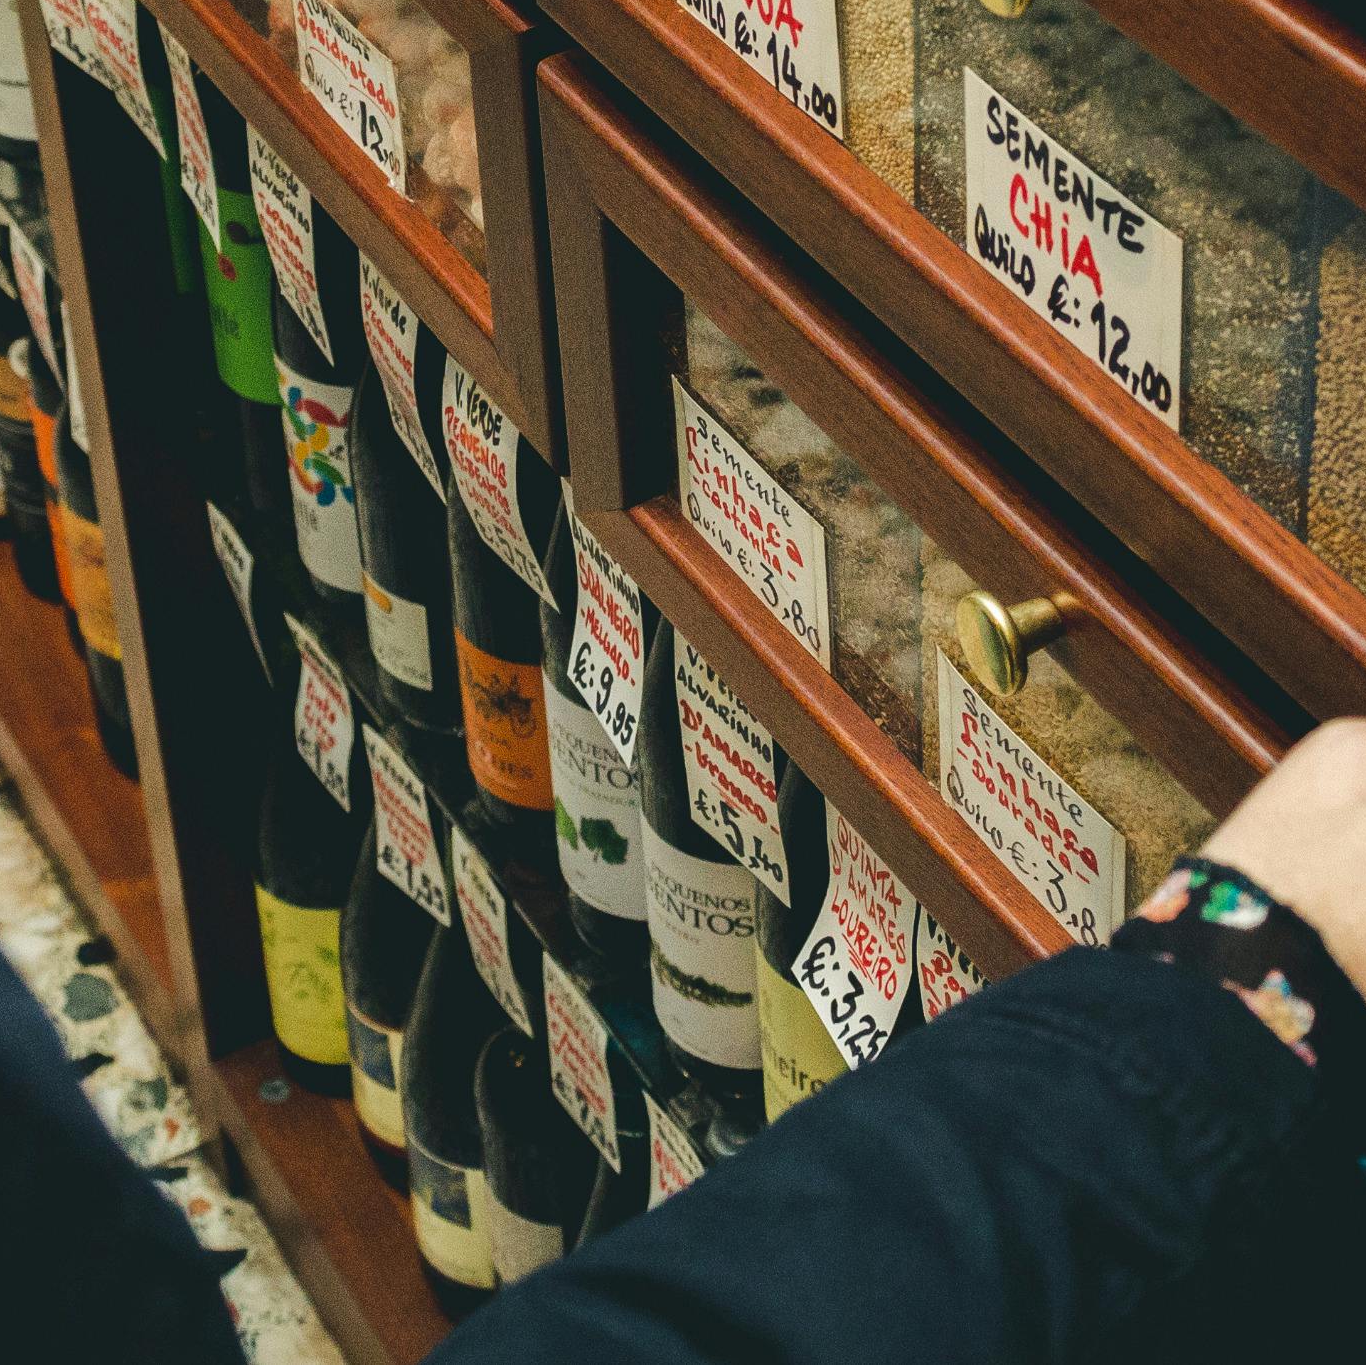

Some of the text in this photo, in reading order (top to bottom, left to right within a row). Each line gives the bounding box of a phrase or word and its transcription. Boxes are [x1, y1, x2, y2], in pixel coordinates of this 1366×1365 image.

[986, 95, 1147, 254] SEMENTE
[695, 414, 793, 528] Semente
[961, 687, 1085, 828] Semente
[836, 814, 903, 919] QUINTA
[1045, 858, 1108, 951] 3,8
